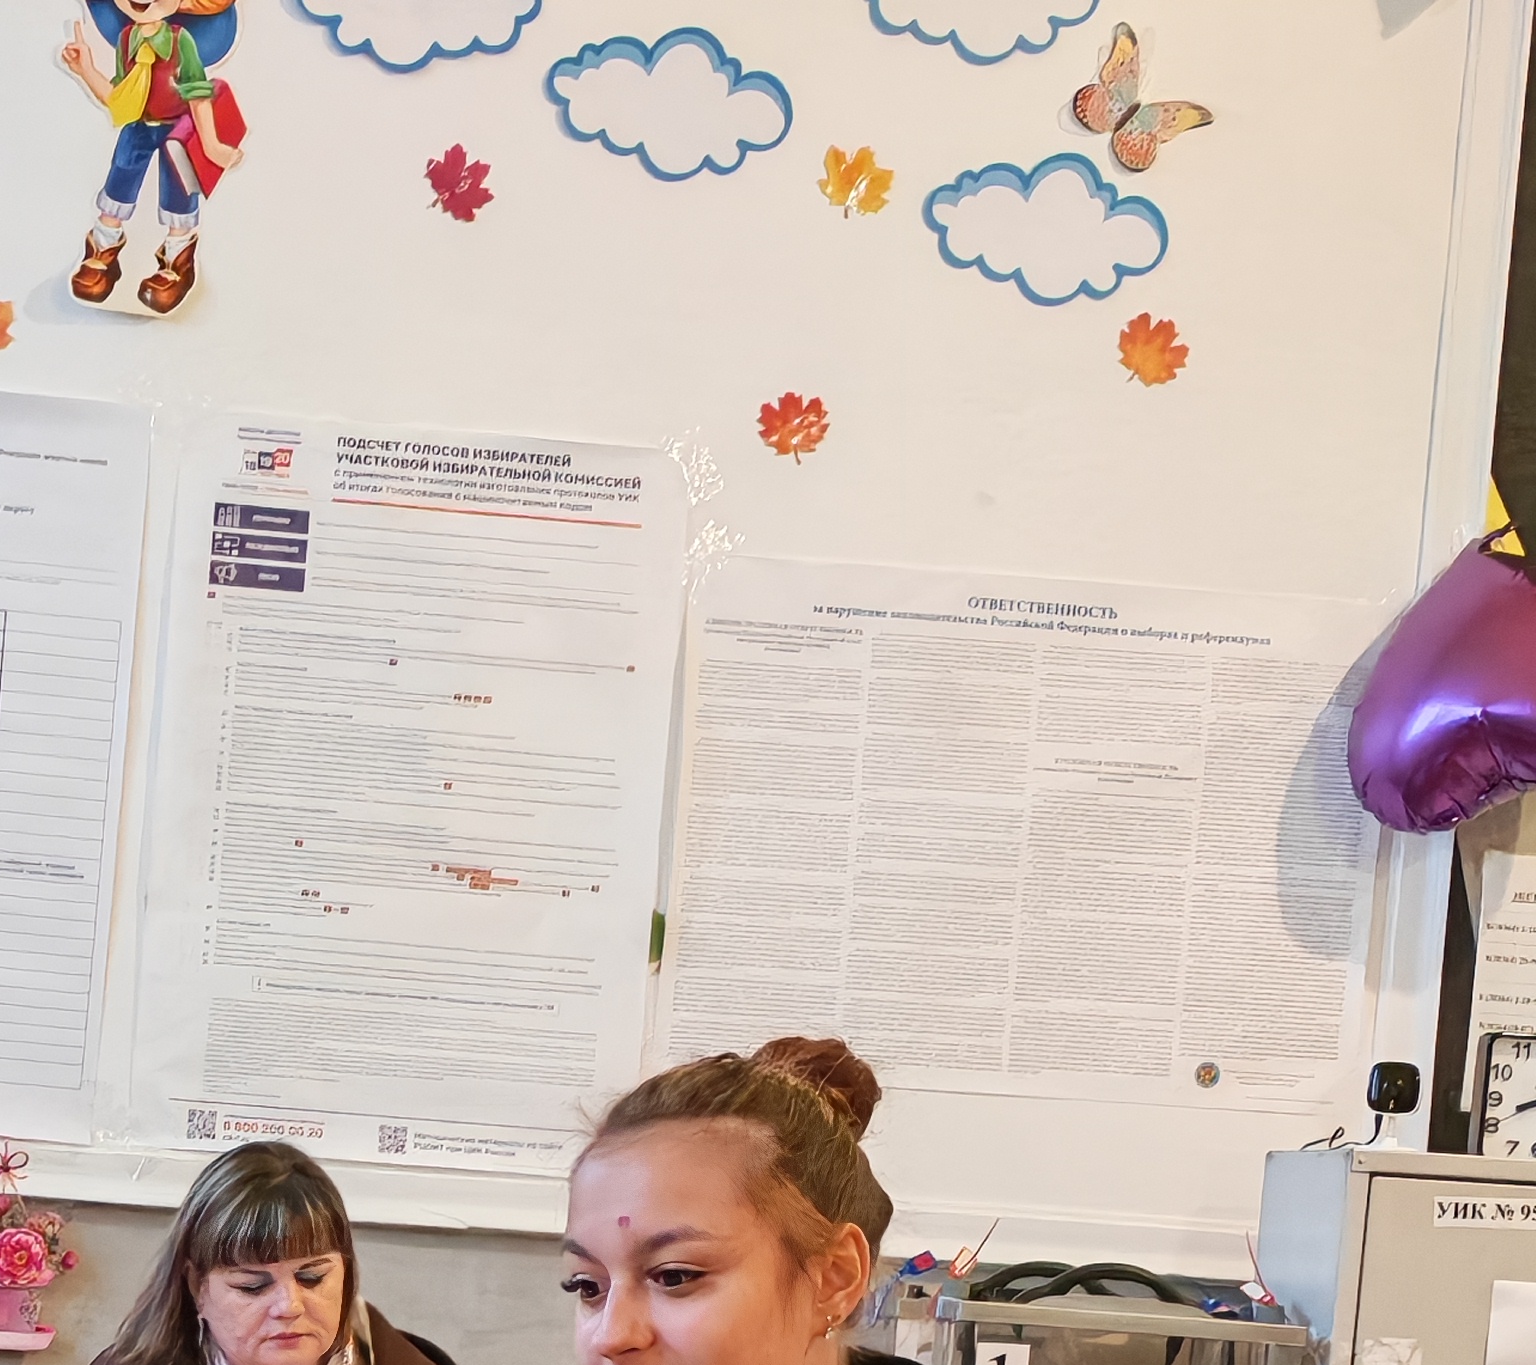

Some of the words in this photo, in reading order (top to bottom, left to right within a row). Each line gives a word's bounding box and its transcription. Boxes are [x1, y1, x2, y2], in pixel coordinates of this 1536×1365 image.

[337, 436, 401, 452] ПОДСЧЕТ
[403, 442, 470, 459] ГОЛОСОВ
[473, 448, 571, 467] ИЗБИРАТЕЛЕЙ
[336, 452, 429, 472] УЧАСТКОВОЙ
[432, 460, 552, 482] ИЗБИРАТЕЛЬНОЙ
[554, 472, 642, 489] КОМИССИЕЙ
[617, 493, 640, 502] УИК
[967, 596, 1118, 620] ОТВЕТСТВЕННОСТЬ
[990, 616, 1055, 629] Российской
[1057, 621, 1119, 636] Федерации
[1512, 1041, 1531, 1061] 11
[1491, 1063, 1513, 1081] 10
[1488, 1091, 1503, 1107] 9
[1484, 1117, 1500, 1133] 8
[1506, 1140, 1520, 1157] 7
[1437, 1202, 1486, 1220] УИК
[1491, 1203, 1515, 1221] №
